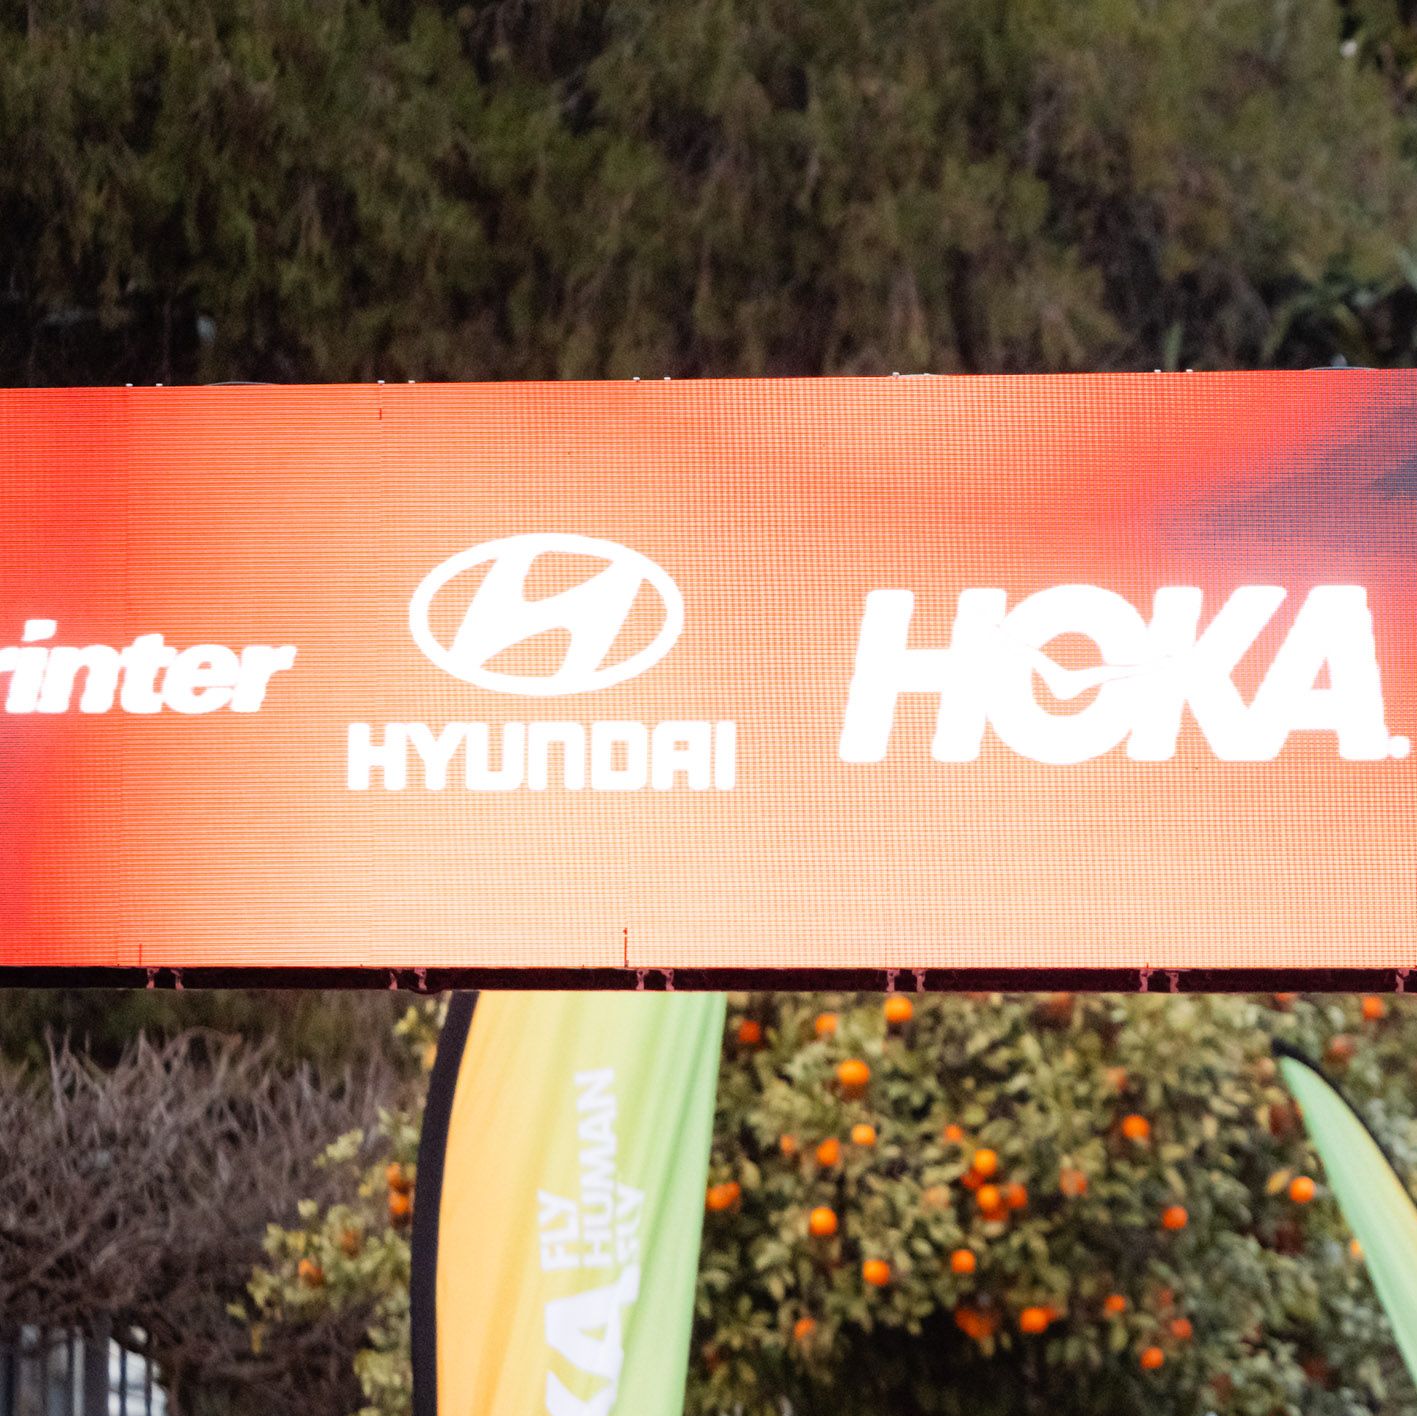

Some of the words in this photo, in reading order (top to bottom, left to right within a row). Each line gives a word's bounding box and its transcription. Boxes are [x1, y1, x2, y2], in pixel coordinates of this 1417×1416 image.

[349, 722, 737, 790] HYUNDAI
[839, 583, 1405, 765] HOKA
[573, 1067, 617, 1270] HUMAN
